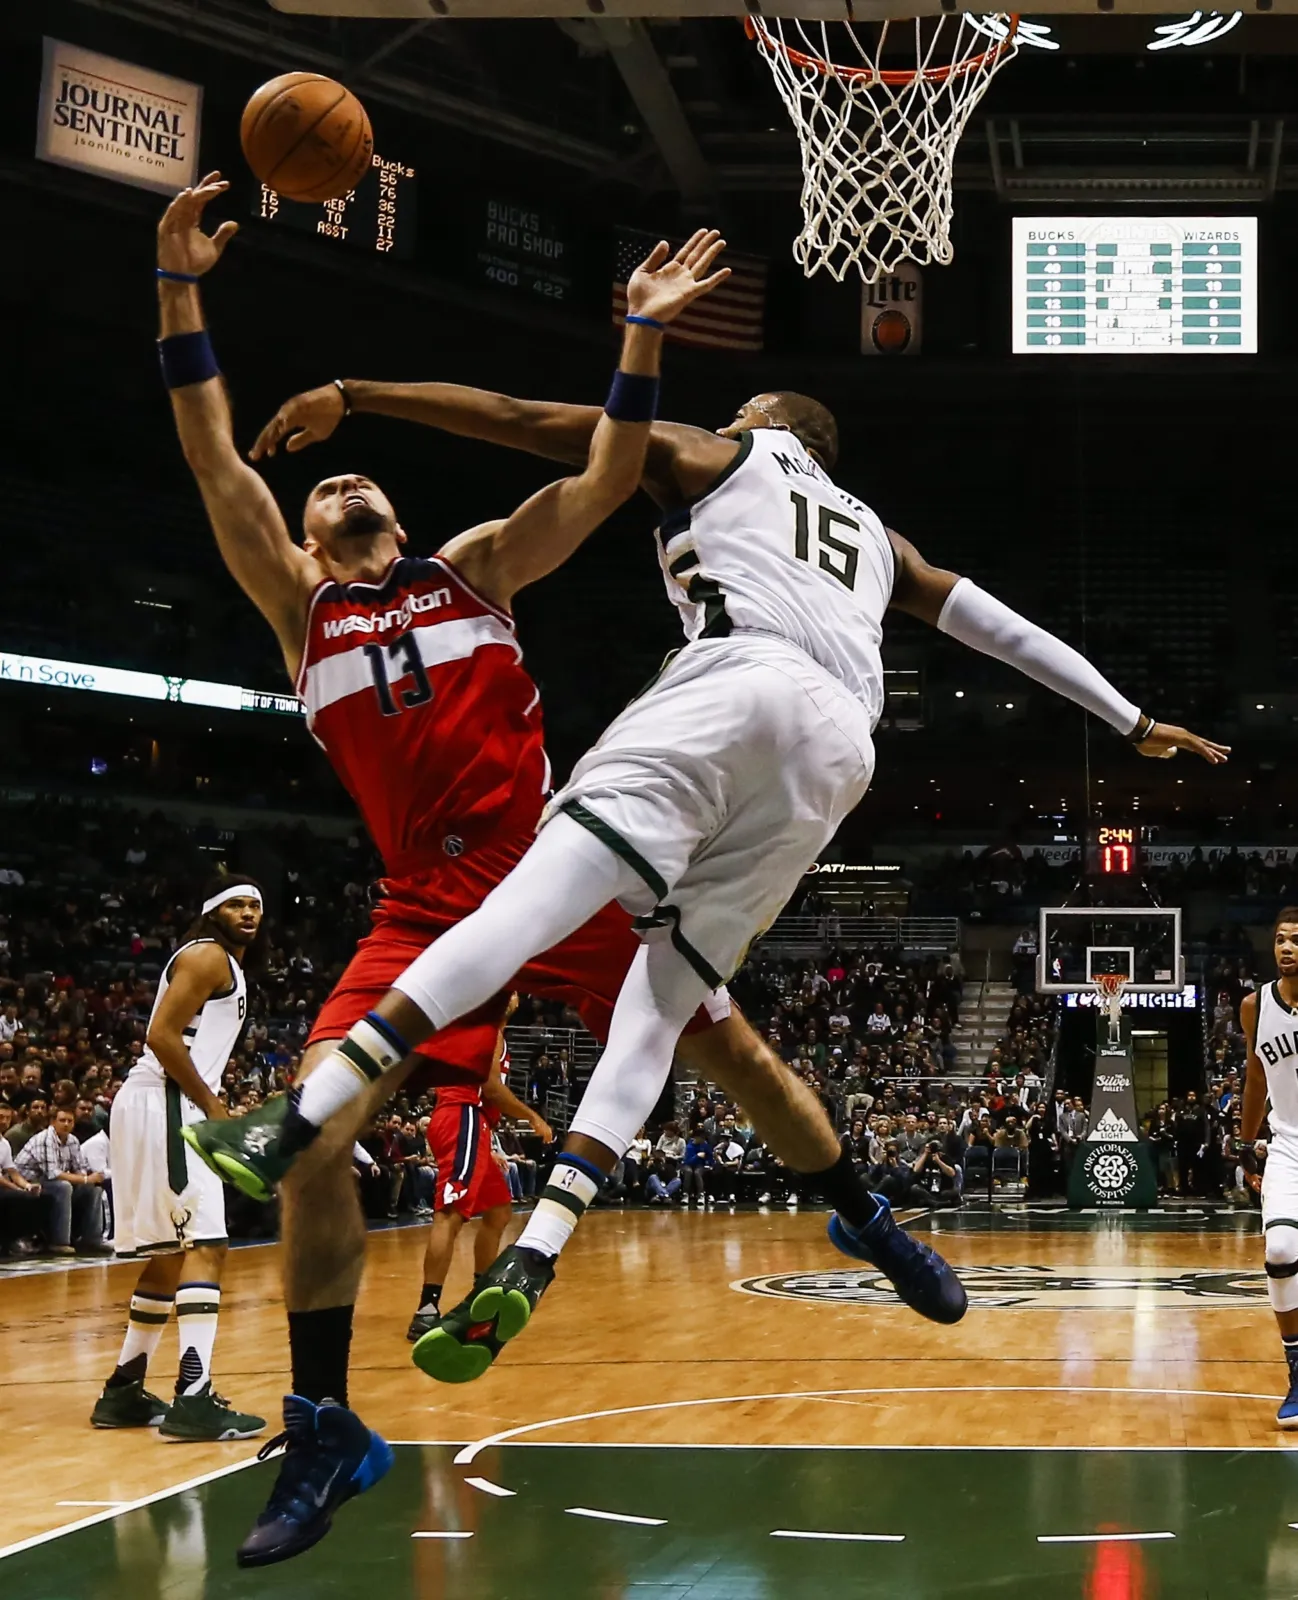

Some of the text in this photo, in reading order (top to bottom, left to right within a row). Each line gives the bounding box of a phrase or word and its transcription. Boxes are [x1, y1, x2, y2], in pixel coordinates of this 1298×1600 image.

[56, 80, 185, 137] JOURNAL
[53, 104, 184, 161] SENTINEL
[74, 134, 166, 168] jsonline.com
[372, 154, 415, 177] Bucks
[380, 170, 397, 185] 56
[379, 184, 397, 199] 76
[260, 204, 279, 219] 17
[326, 209, 343, 225] TO
[487, 200, 540, 233] BUCKS
[377, 213, 395, 229] 22
[317, 221, 349, 240] ASST
[378, 225, 393, 239] 11
[1028, 231, 1075, 241] BUCKS
[1184, 231, 1240, 241] WIZARDS
[376, 238, 394, 252] 27
[487, 221, 564, 260] PRO SHOP
[1208, 244, 1219, 255] 4
[485, 266, 518, 286] 400
[532, 279, 564, 300] 422
[867, 276, 917, 308] Lite
[1044, 298, 1061, 310] 12
[1209, 334, 1219, 345] 7
[790, 489, 861, 592] 15
[322, 587, 453, 639] washngton
[39, 664, 96, 688] Save
[363, 628, 435, 717] 13
[260, 696, 273, 709] OF
[274, 698, 299, 713] TOWN
[1098, 827, 1133, 845] 2:44
[1104, 845, 1128, 872] 17
[819, 863, 846, 873] ATI
[1096, 1074, 1131, 1087] Silver
[1096, 1118, 1129, 1132] Coors
[1083, 1144, 1139, 1171] ORTHOPAEDIC
[1086, 1181, 1136, 1199] HOSPITAL
